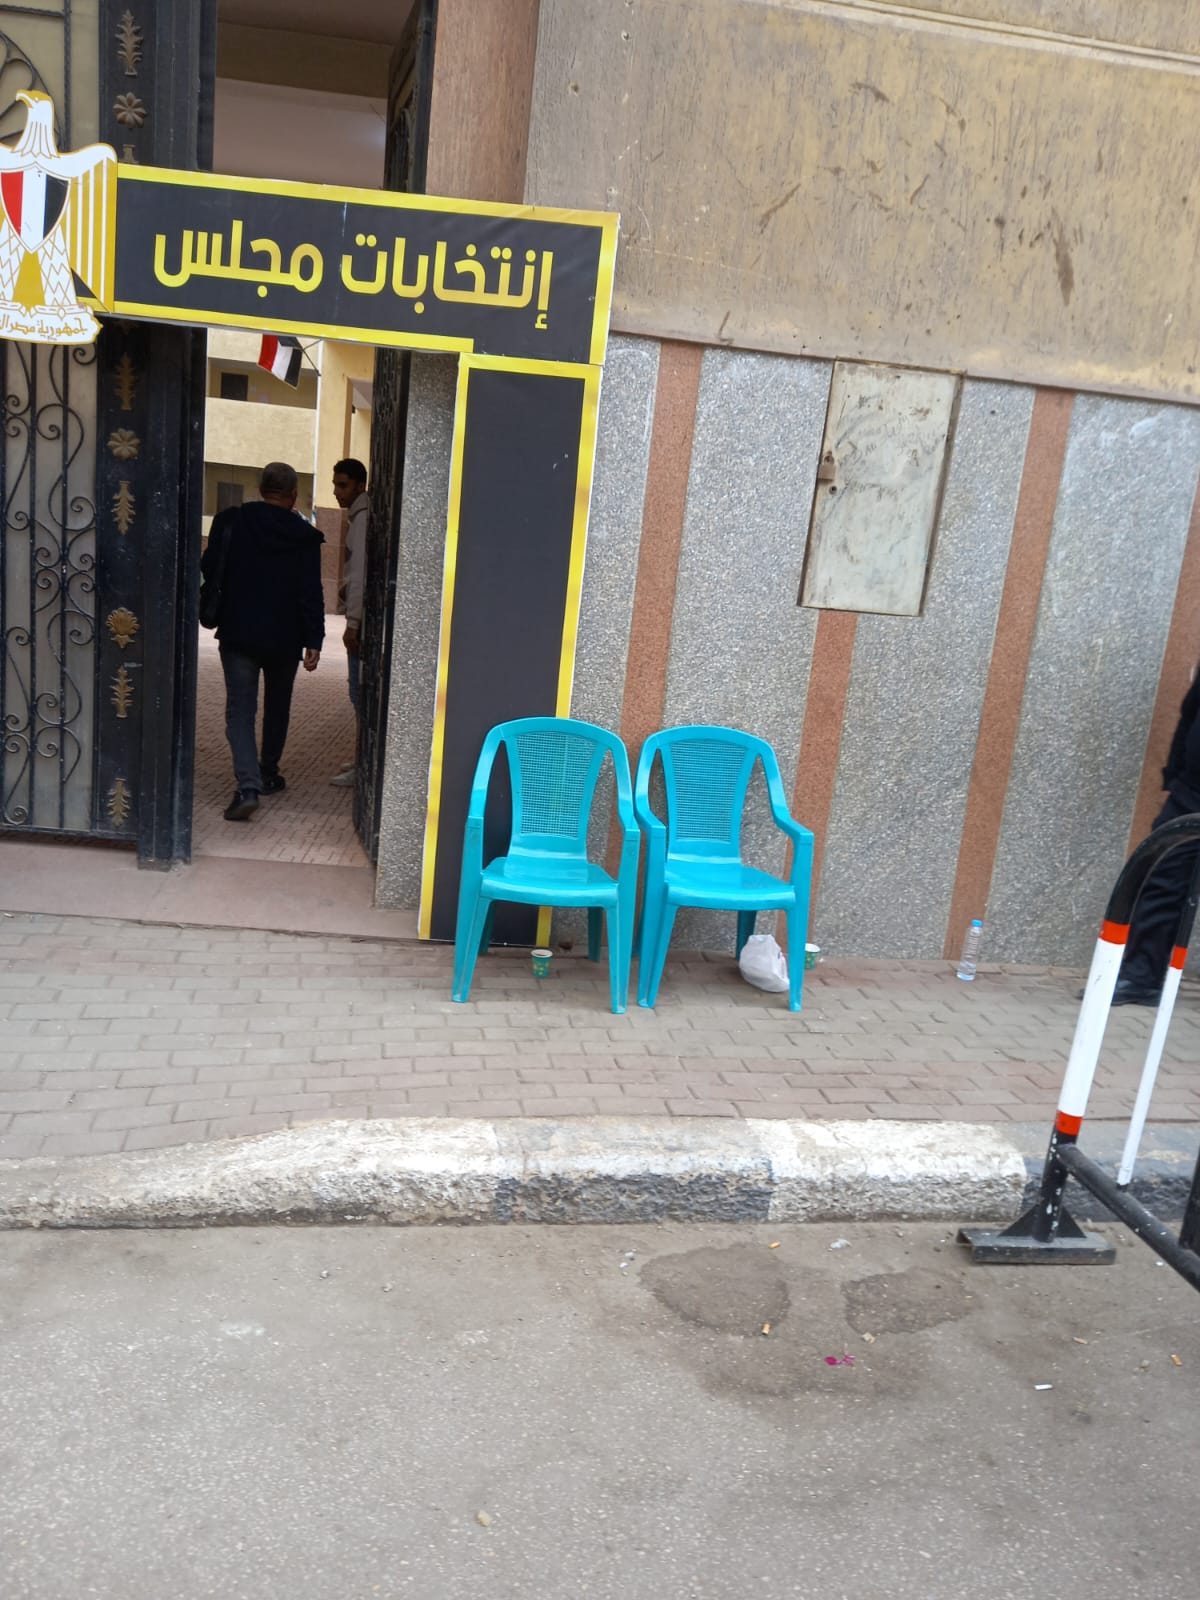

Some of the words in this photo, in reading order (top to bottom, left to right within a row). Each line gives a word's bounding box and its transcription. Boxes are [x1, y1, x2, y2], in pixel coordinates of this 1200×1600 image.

[153, 219, 324, 298] مجلس
[340, 234, 554, 330] إنتخابات
[7, 321, 35, 335] مصر
